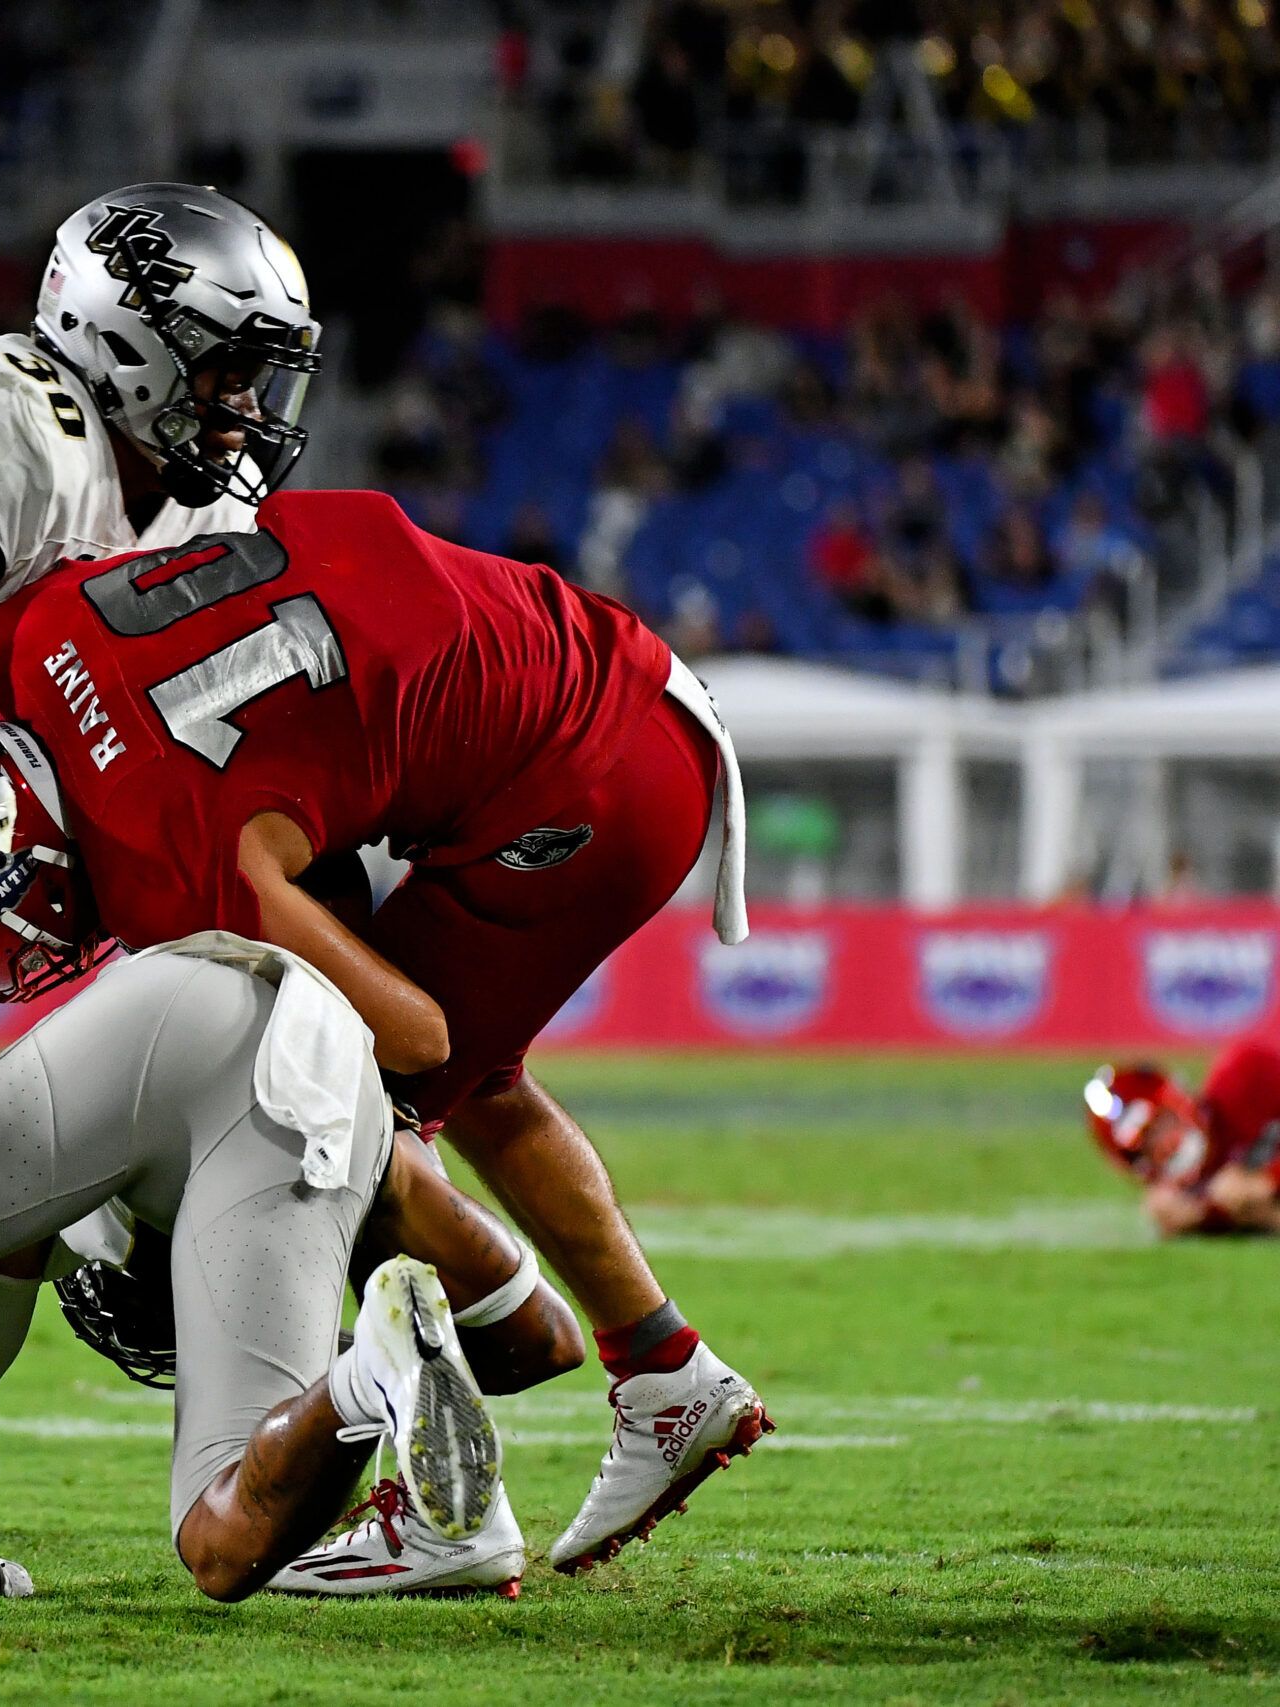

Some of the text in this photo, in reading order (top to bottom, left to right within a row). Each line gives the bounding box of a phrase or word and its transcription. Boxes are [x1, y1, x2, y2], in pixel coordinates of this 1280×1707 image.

[4, 352, 88, 441] 30
[81, 527, 348, 769] 10
[43, 639, 127, 772] RAINE
[14, 738, 42, 768] FLORIDA
[663, 1400, 707, 1463] adidas
